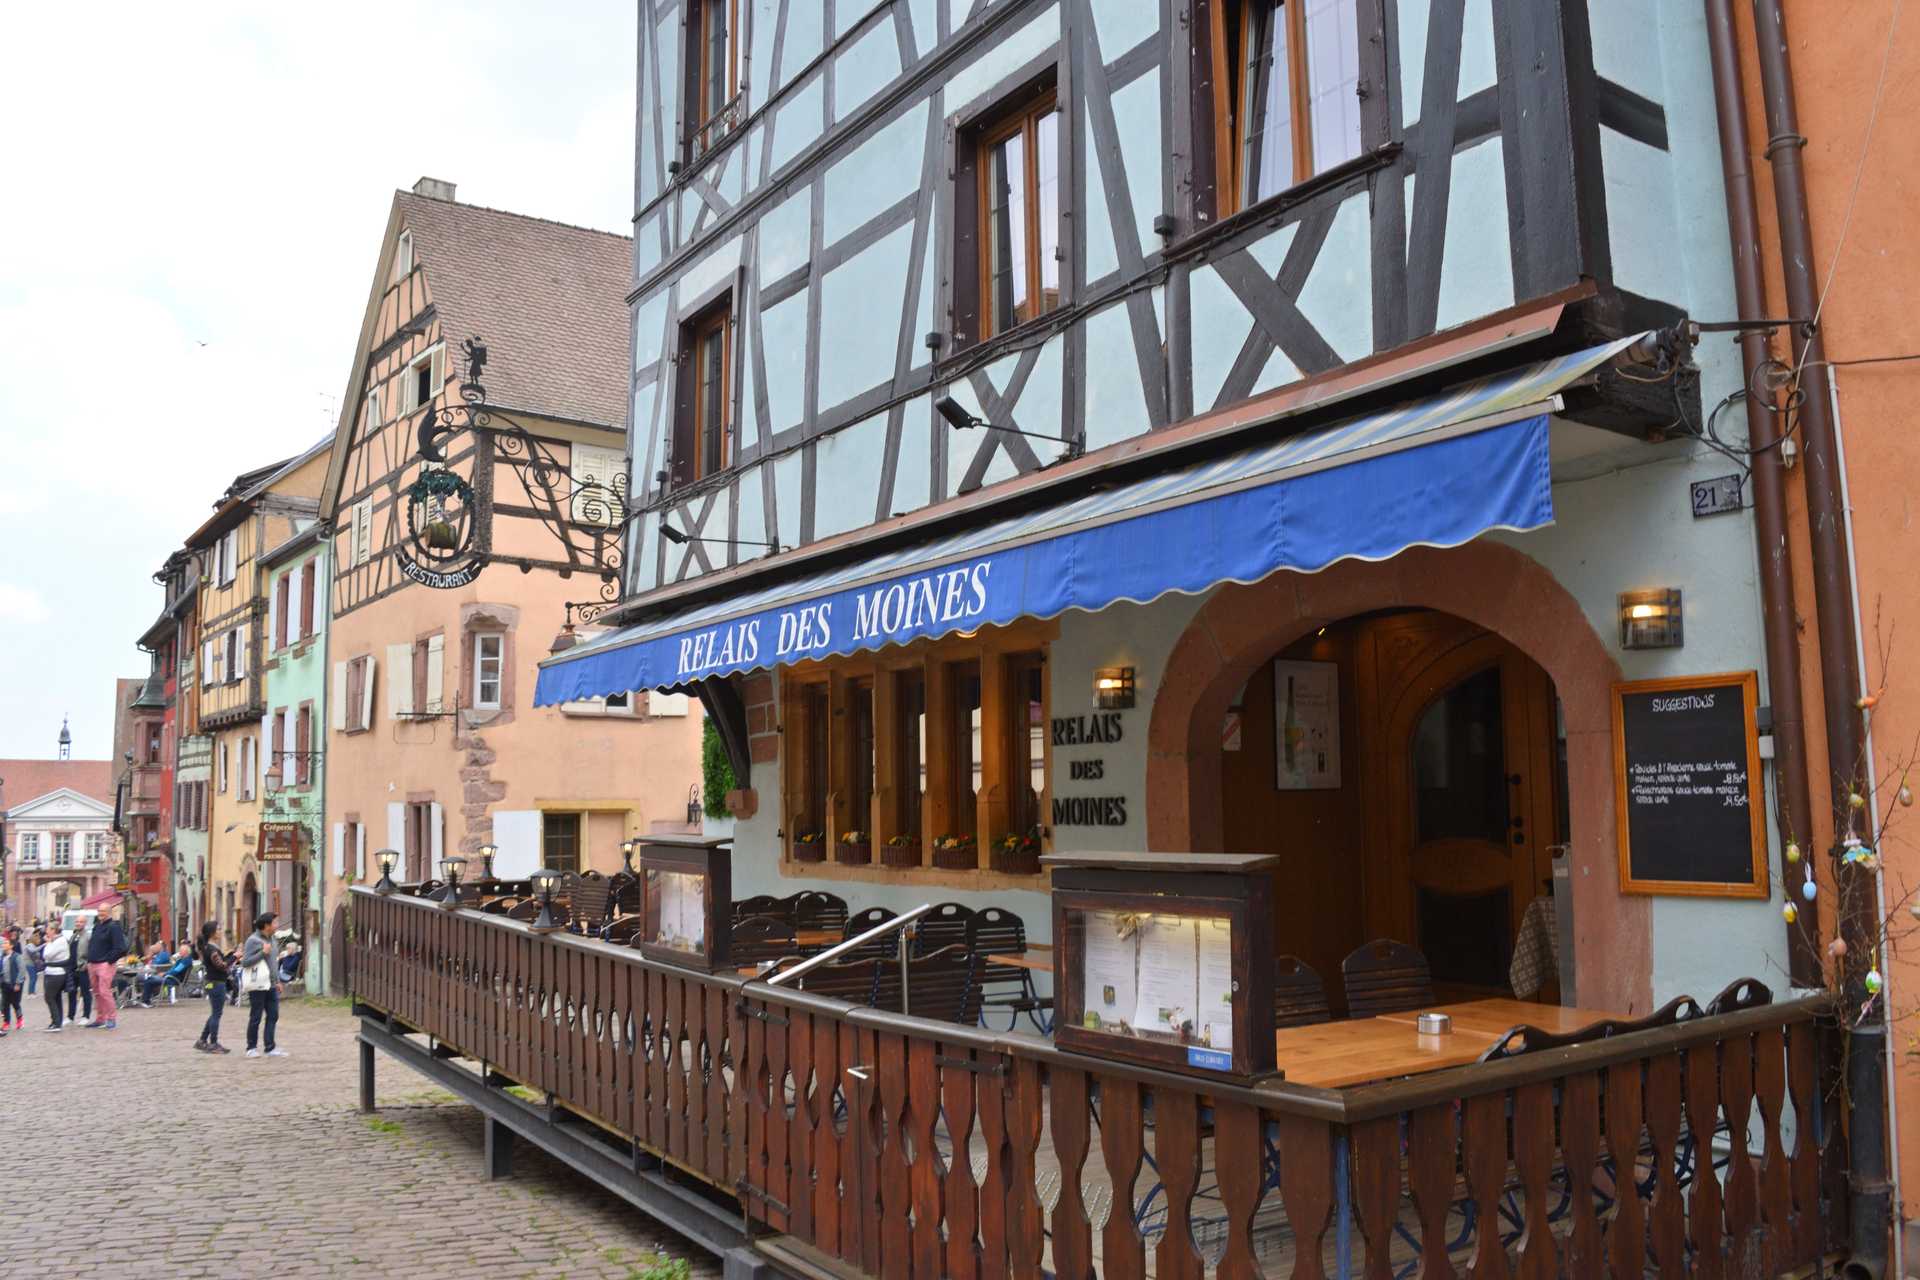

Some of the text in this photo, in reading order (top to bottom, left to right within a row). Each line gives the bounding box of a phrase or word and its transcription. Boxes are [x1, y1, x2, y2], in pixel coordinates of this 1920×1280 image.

[1695, 487, 1717, 509] 21
[404, 561, 473, 588] RESTAURANT
[677, 560, 992, 675] RELAIS DES MOINES
[1652, 694, 1716, 712] SUGGESTIONS
[1052, 713, 1123, 746] RELAIS
[1070, 759, 1104, 780] DES
[1052, 796, 1127, 826] MOINES
